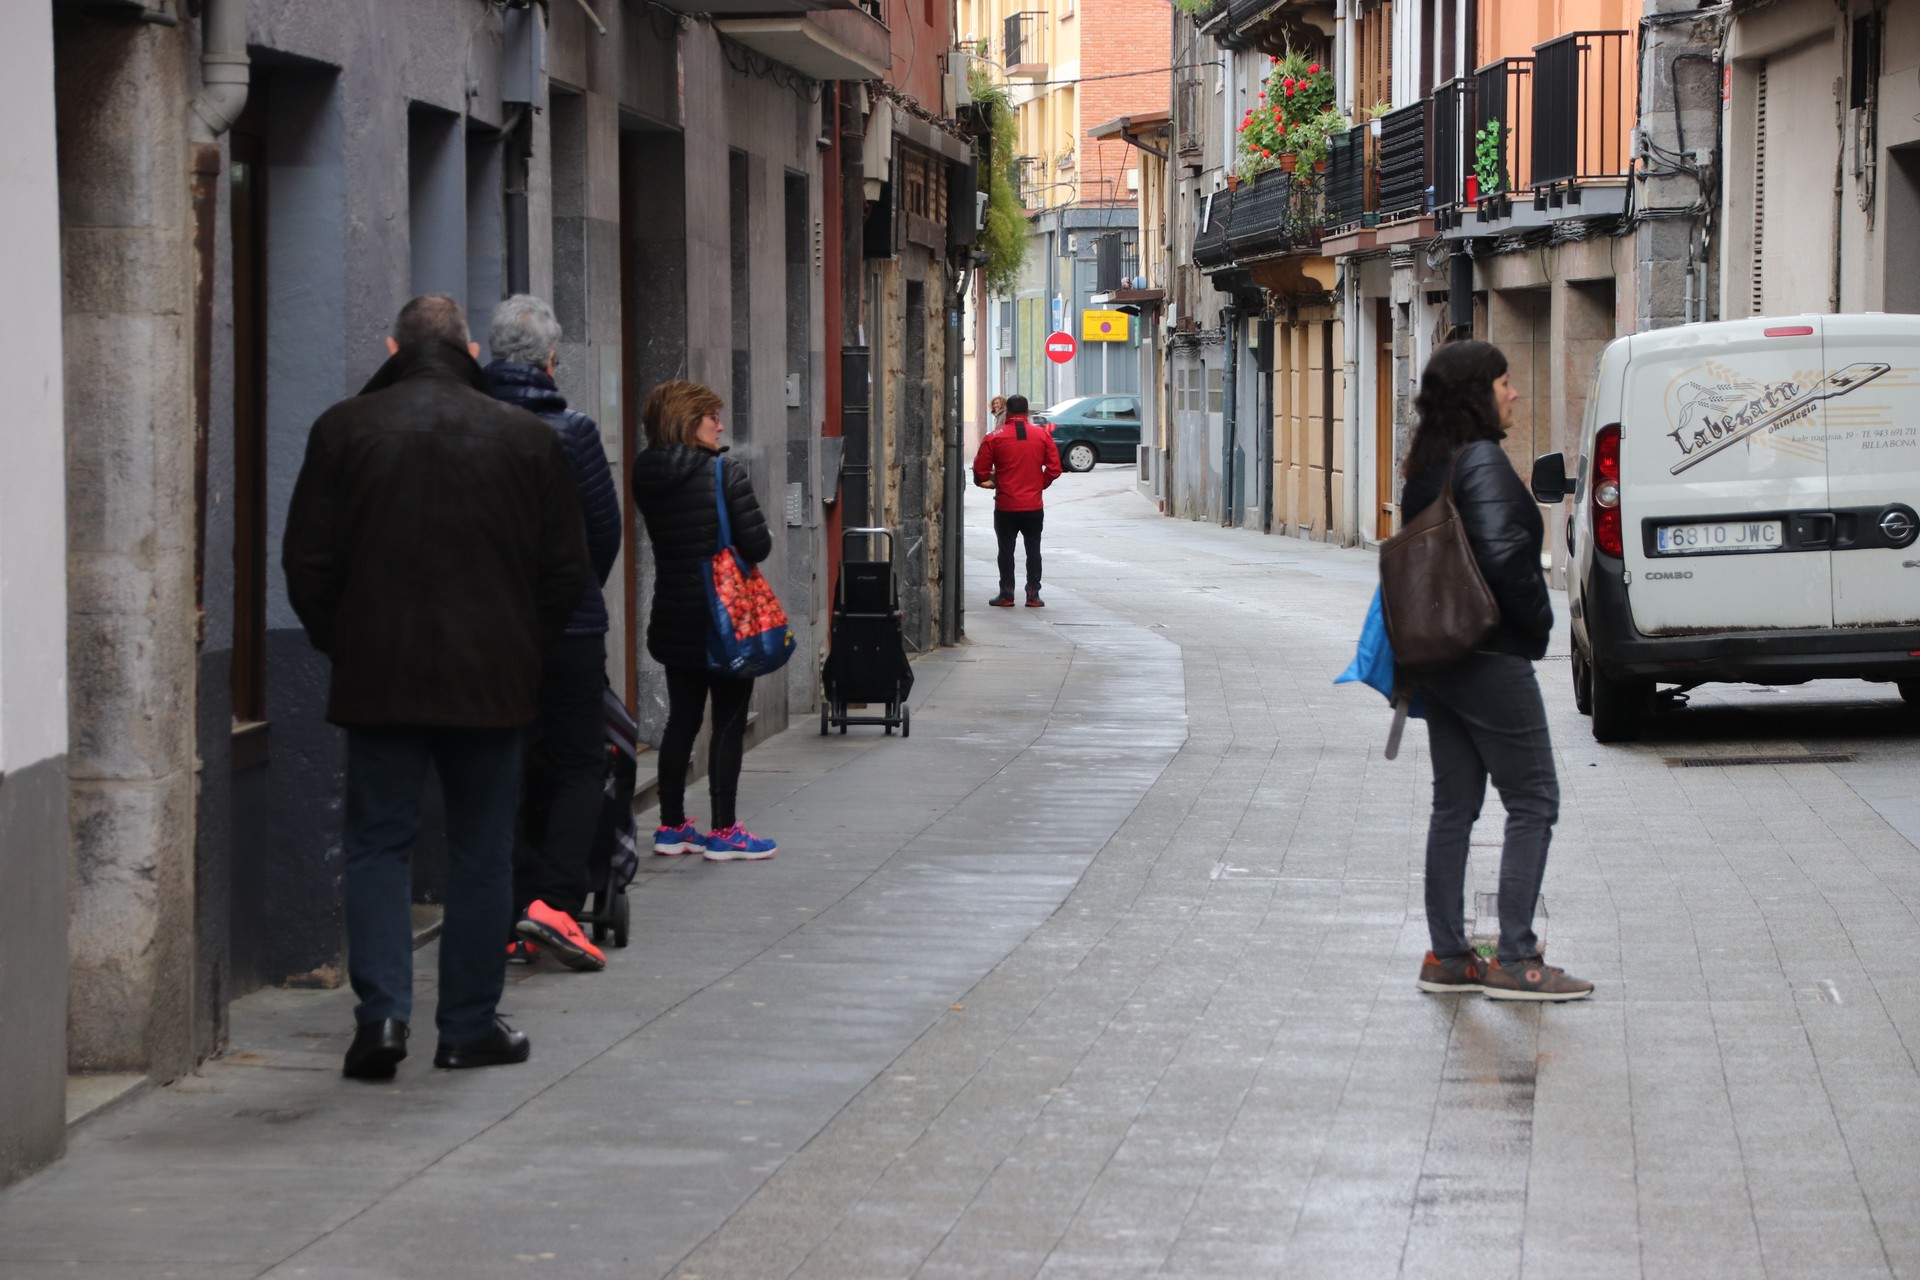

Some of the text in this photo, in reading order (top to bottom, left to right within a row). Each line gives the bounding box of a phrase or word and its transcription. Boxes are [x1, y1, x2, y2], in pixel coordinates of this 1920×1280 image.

[1666, 382, 1800, 455] Labezain
[1768, 403, 1817, 434] okindegia
[1791, 434, 1809, 443] kale
[1845, 431, 1855, 440] 19
[1873, 429, 1888, 439] 943
[1890, 428, 1903, 438] 691
[1905, 427, 1917, 436] 711
[1861, 439, 1917, 450] BILLABONA
[1672, 524, 1776, 546] 6810 JWC
[1645, 571, 1694, 580] COMBO
